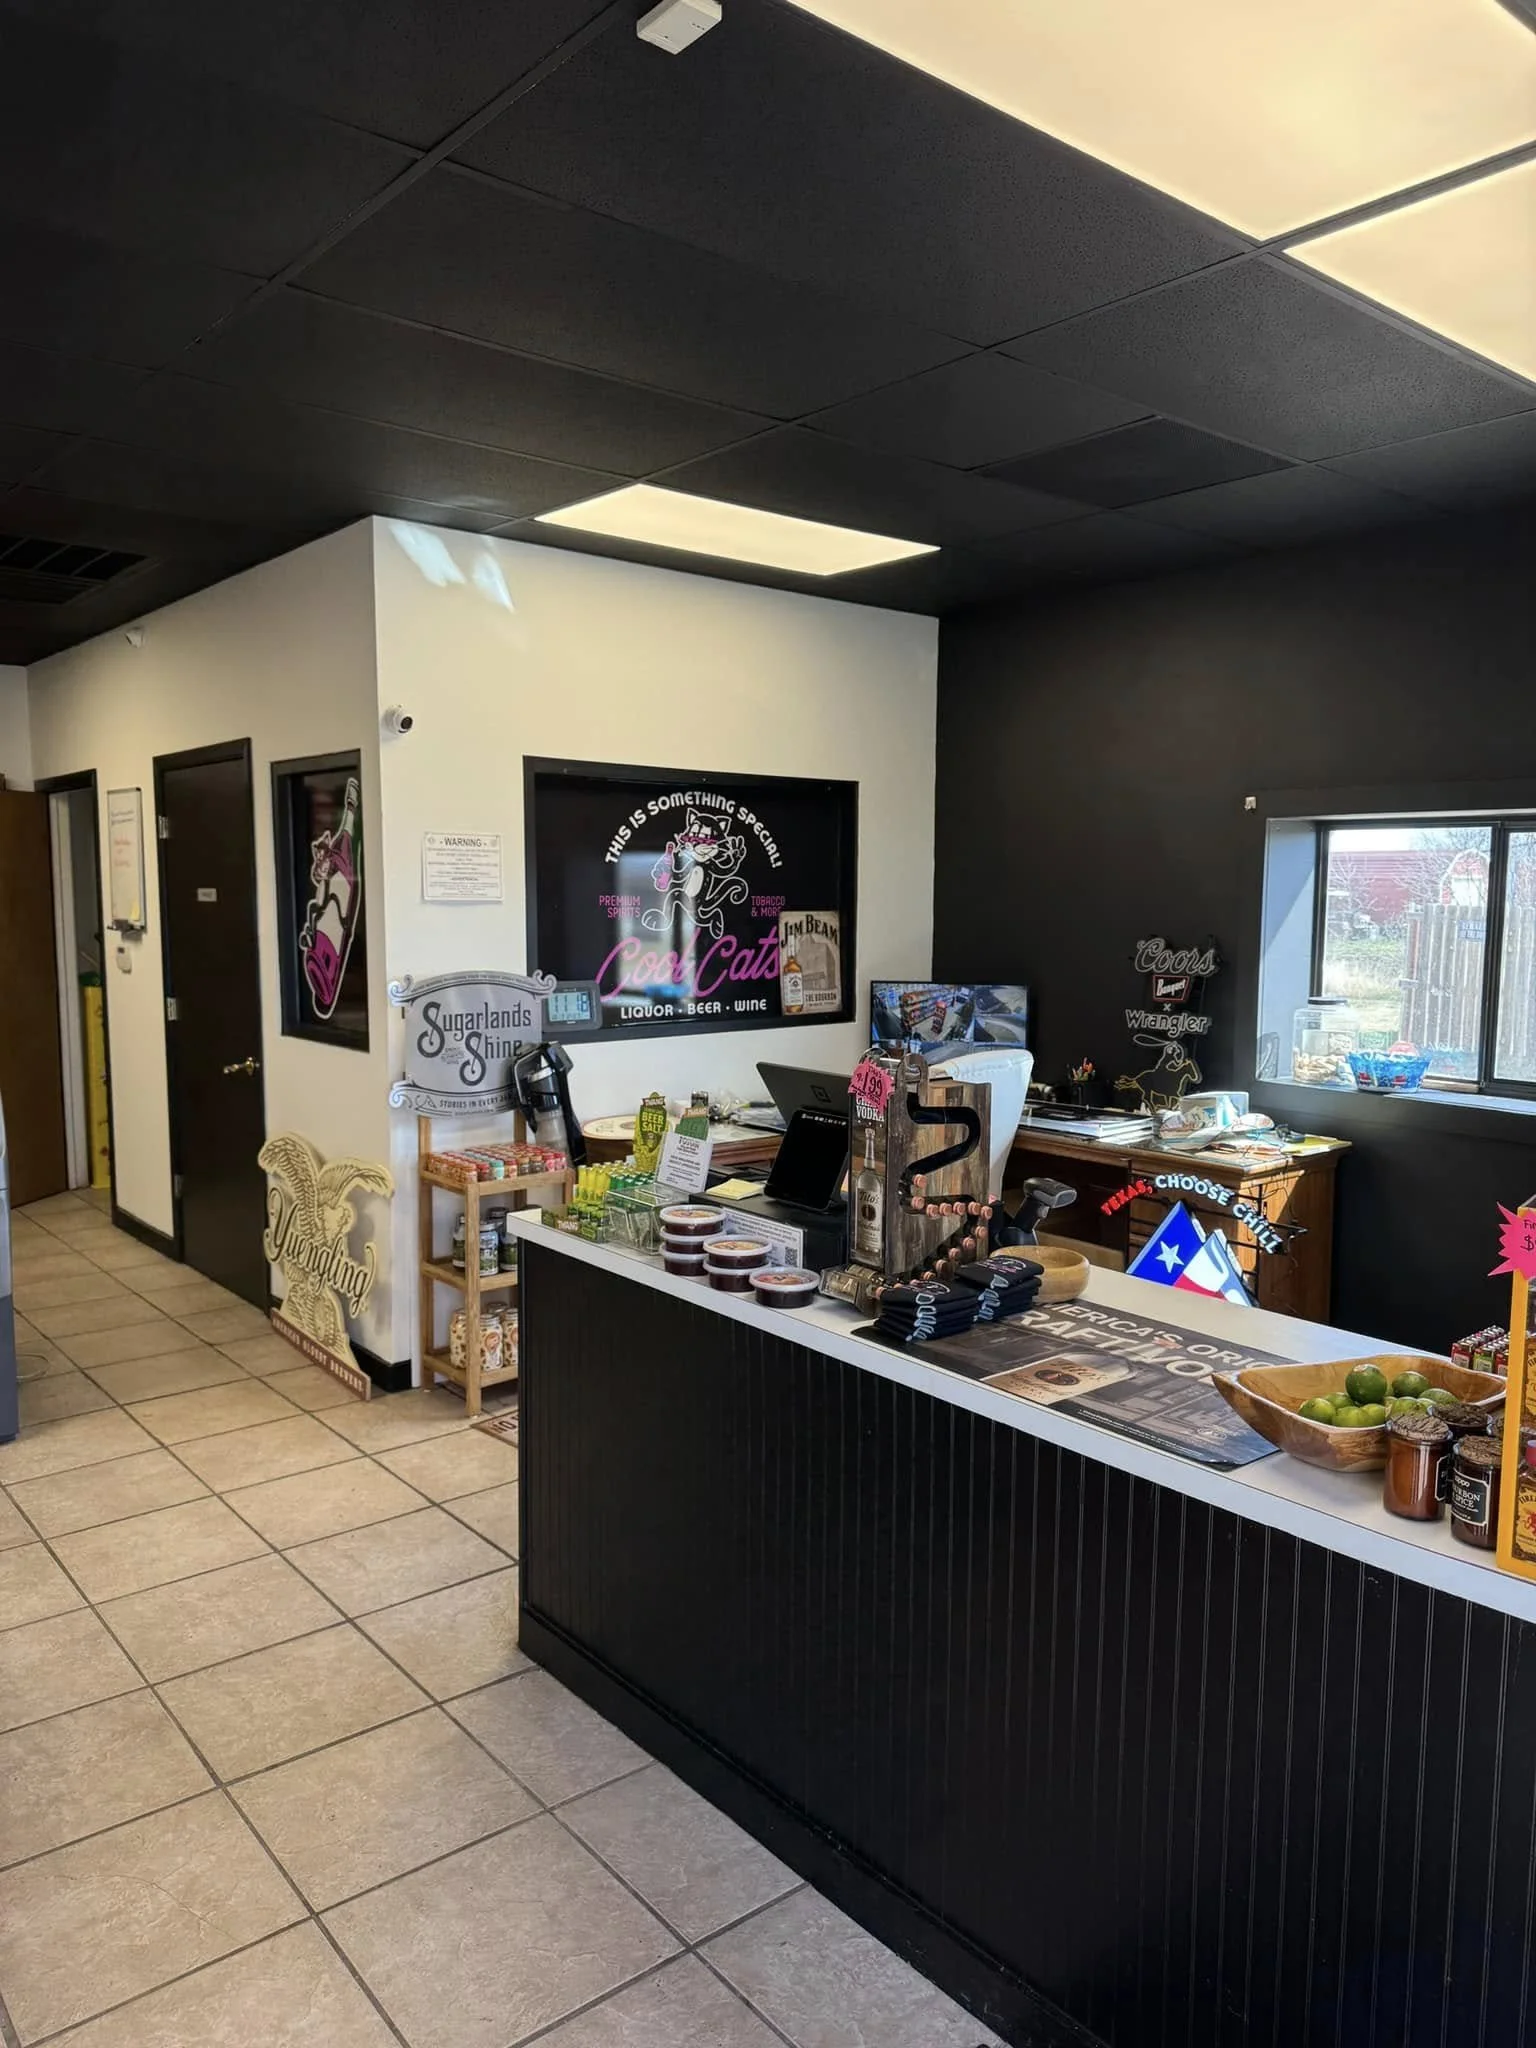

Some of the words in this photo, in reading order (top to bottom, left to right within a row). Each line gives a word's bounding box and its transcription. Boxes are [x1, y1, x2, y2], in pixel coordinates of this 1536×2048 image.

[444, 837, 482, 847] WARNING
[605, 825, 632, 864] THIS
[629, 809, 647, 829] IS
[647, 791, 736, 815] SOMETHING
[736, 807, 783, 869] SPECIAL!
[599, 895, 641, 907] PREMIUM
[607, 907, 641, 918] SPIRITS
[751, 896, 785, 906] TOBACCO
[751, 907, 759, 917] &
[781, 920, 802, 948] JIM
[805, 914, 838, 945] BEAM
[595, 927, 700, 1001] Cool
[694, 926, 779, 997] Cats
[1135, 938, 1216, 975] Coors
[621, 1005, 673, 1019] LIQUOR
[687, 1002, 721, 1015] BEER
[734, 999, 767, 1012] WINE
[1125, 1009, 1209, 1038] Wrangler
[417, 1000, 531, 1058] Sugarlands
[460, 1031, 523, 1087] Shine
[641, 1111, 664, 1125] BEER
[641, 1122, 663, 1133] SALT
[1155, 1174, 1230, 1206] CHOOSE
[1232, 1203, 1281, 1254] CHILL
[264, 1187, 376, 1318] Yuengling
[1018, 1310, 1139, 1349] RAFT
